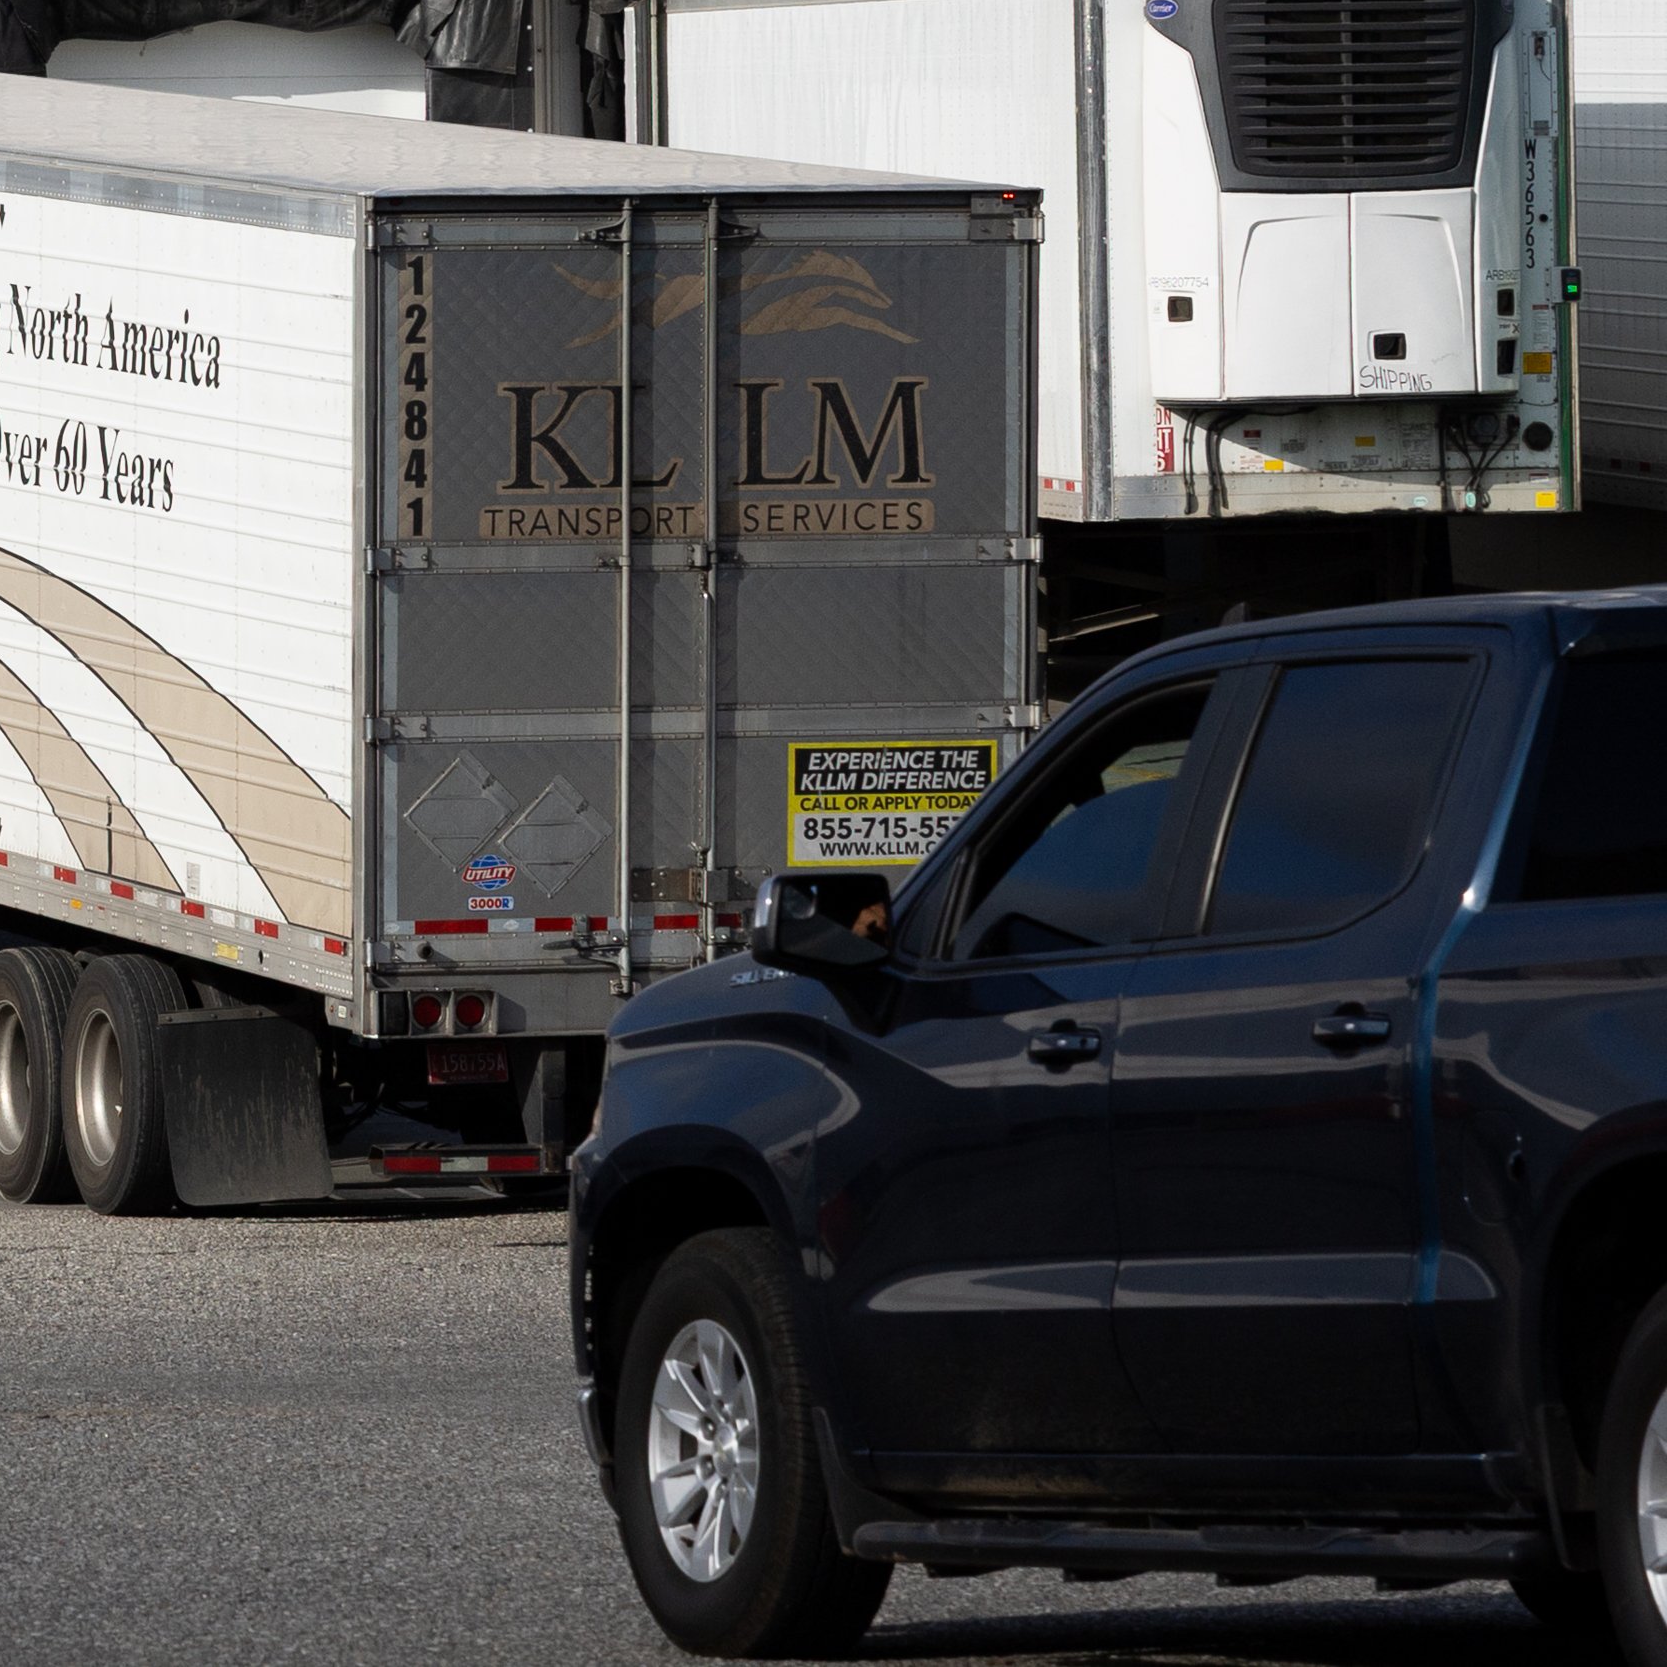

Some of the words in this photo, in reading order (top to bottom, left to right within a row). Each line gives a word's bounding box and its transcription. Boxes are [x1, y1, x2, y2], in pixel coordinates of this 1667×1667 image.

[1524, 138, 1536, 269] W36563
[7, 283, 89, 367] North
[97, 295, 221, 389] America
[1359, 365, 1433, 392] SHIPPING
[403, 255, 428, 537] 124841
[502, 380, 932, 489] KLLM
[53, 418, 87, 495] 60
[97, 425, 174, 512] Years
[484, 505, 695, 537] TRANSPORT
[743, 500, 924, 533] SERVICES
[807, 750, 935, 771] EXPERIENCE
[939, 750, 979, 769] THE
[800, 772, 857, 791] KLLM
[861, 770, 987, 791] DIFFERENCE
[800, 797, 840, 811] CALL
[844, 796, 869, 811] OR
[872, 796, 922, 811] APPLY
[803, 816, 963, 840] 855-715-55
[819, 840, 937, 857] WWW.KLLM.C
[466, 867, 514, 881] UTILITY
